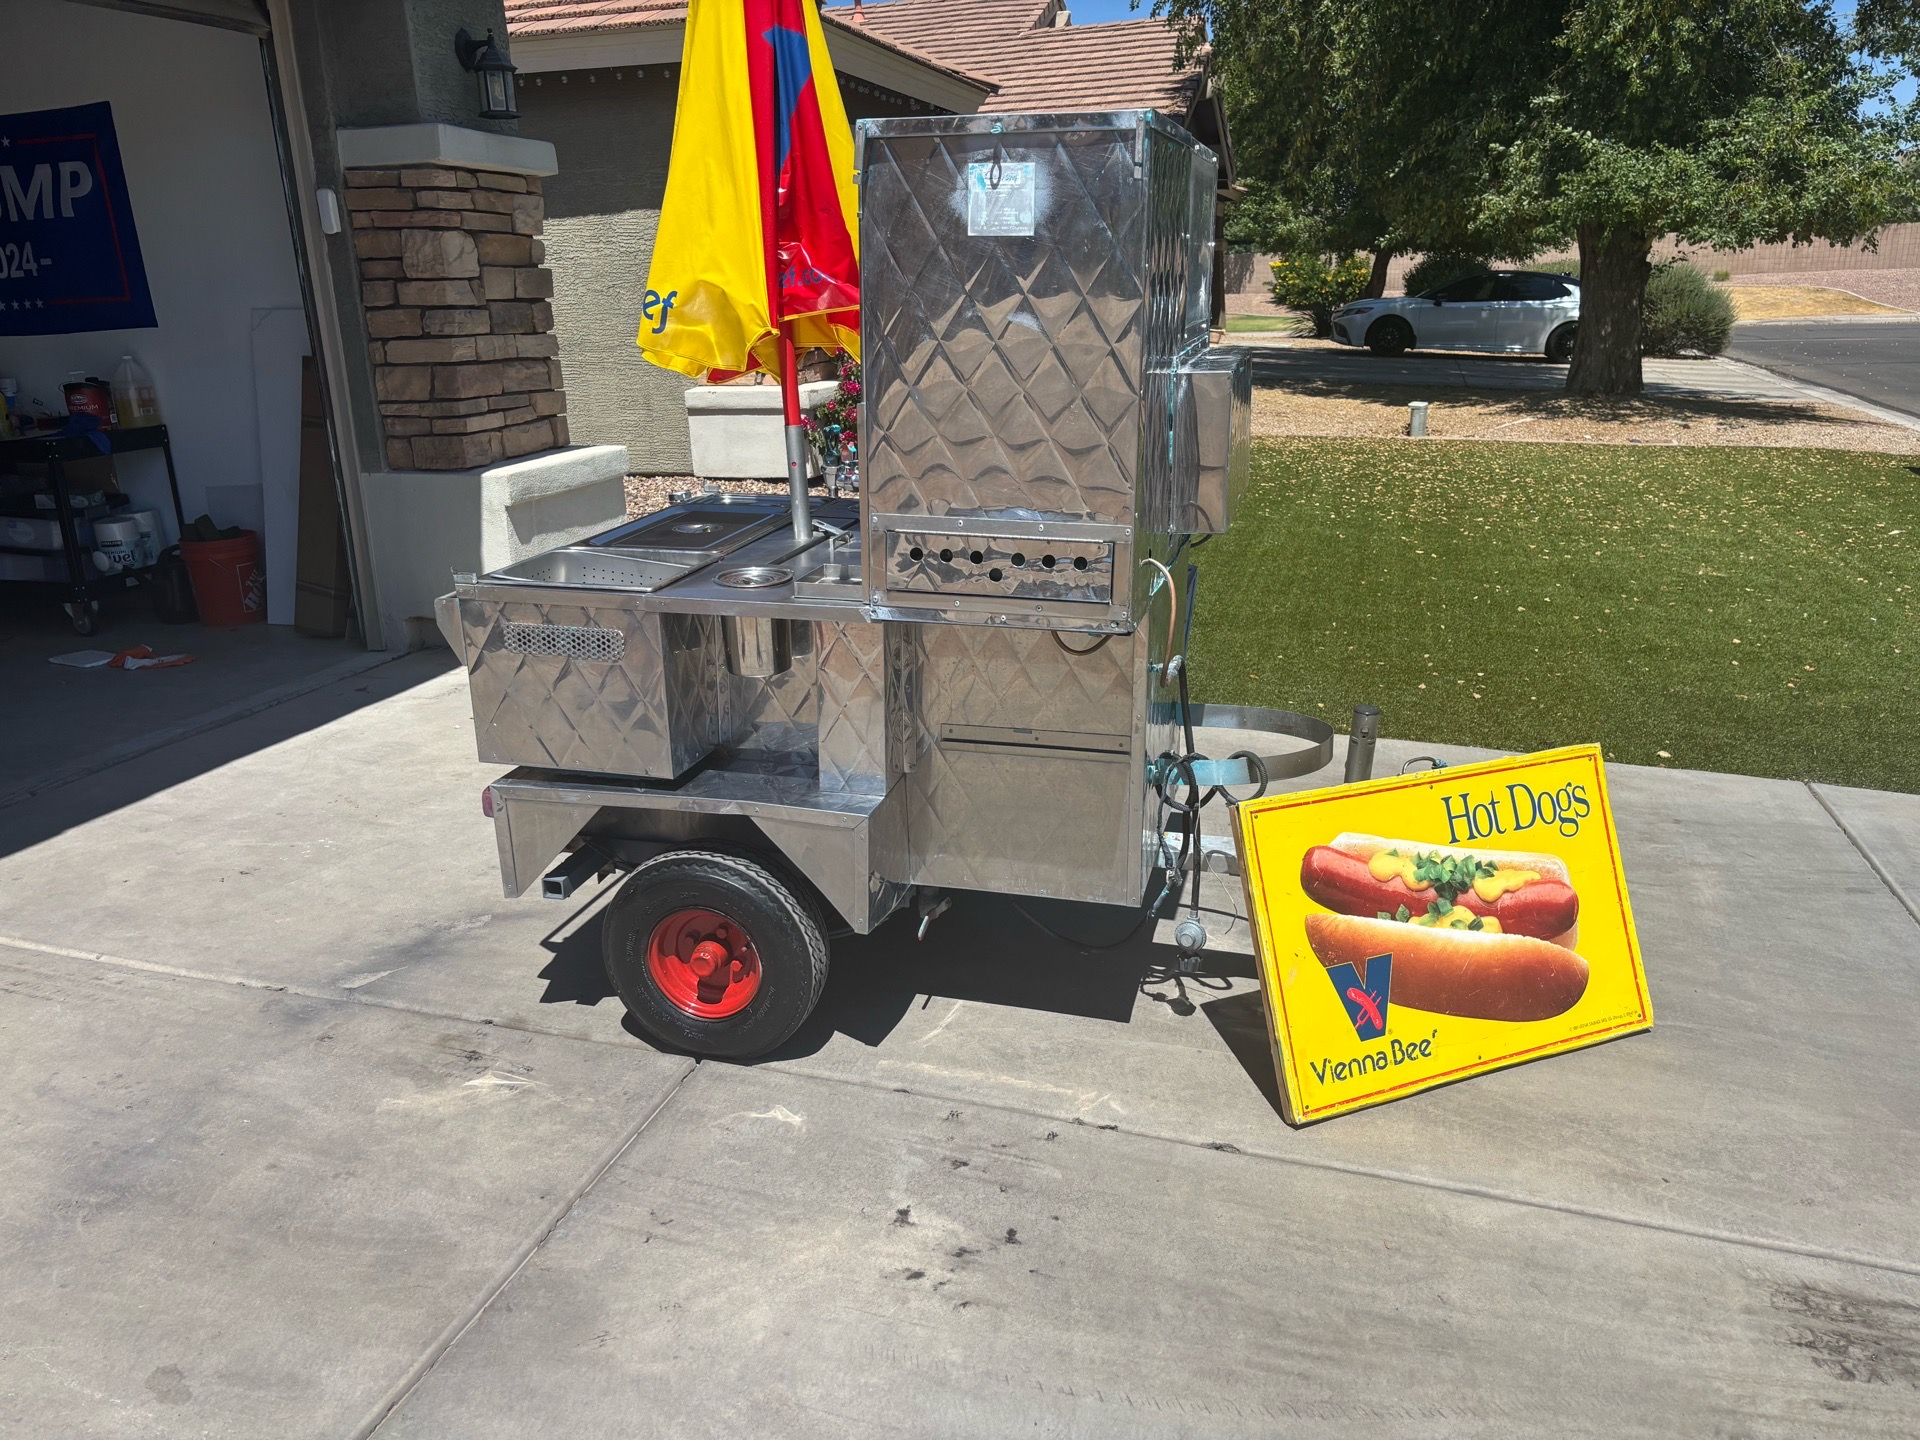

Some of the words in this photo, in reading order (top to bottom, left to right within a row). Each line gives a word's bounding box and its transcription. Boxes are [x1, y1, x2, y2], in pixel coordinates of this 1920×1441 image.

[0, 160, 93, 222] MP
[1441, 789, 1506, 844] Hot
[1505, 781, 1592, 837] Dogs
[1309, 1050, 1388, 1086] Vienna
